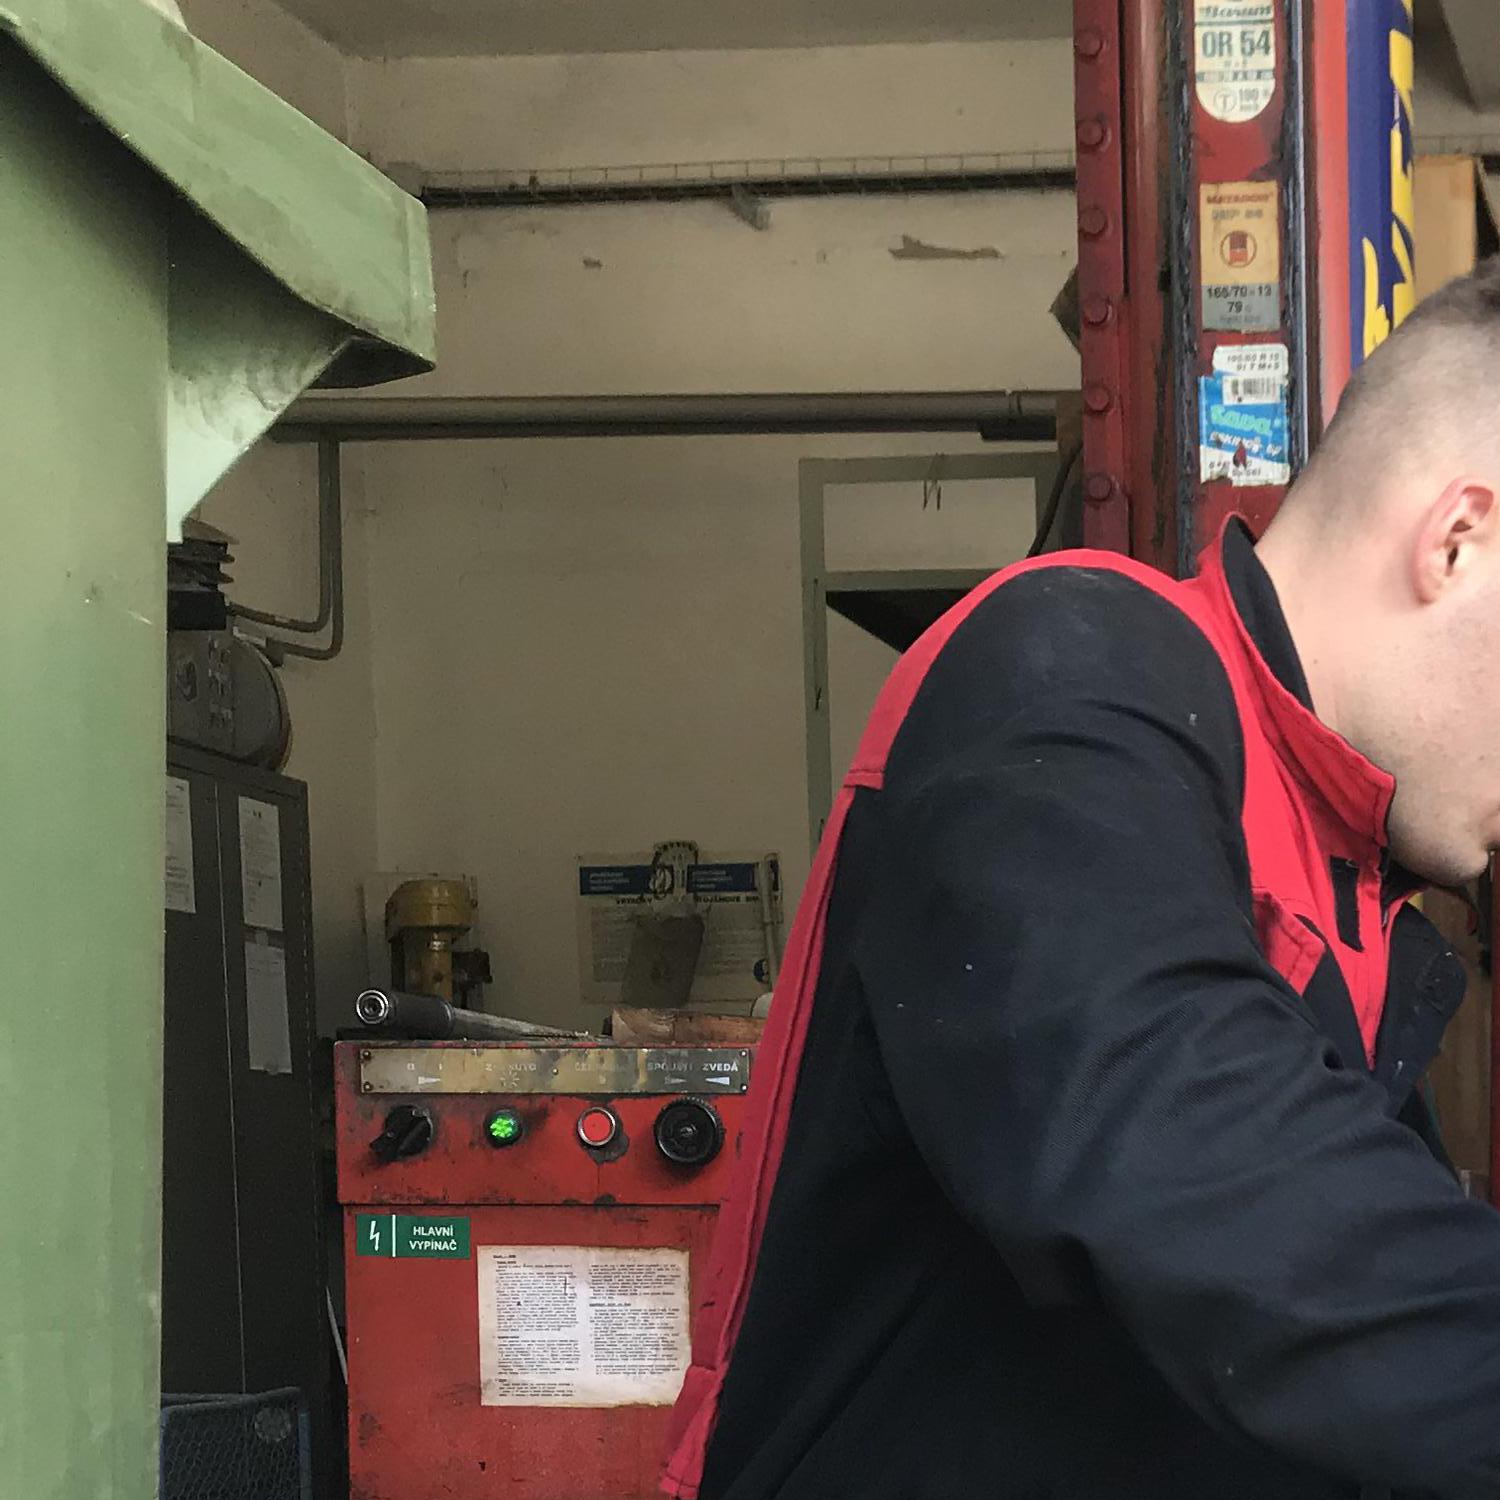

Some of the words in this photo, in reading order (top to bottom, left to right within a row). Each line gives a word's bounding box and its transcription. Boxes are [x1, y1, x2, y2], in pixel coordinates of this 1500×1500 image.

[1202, 31, 1233, 58] OR
[1240, 29, 1271, 56] 54
[702, 1060, 739, 1072] ZVEDÁ
[413, 1225, 454, 1237] HLAVNÍ
[408, 1239, 457, 1251] VYPÍNAČ
